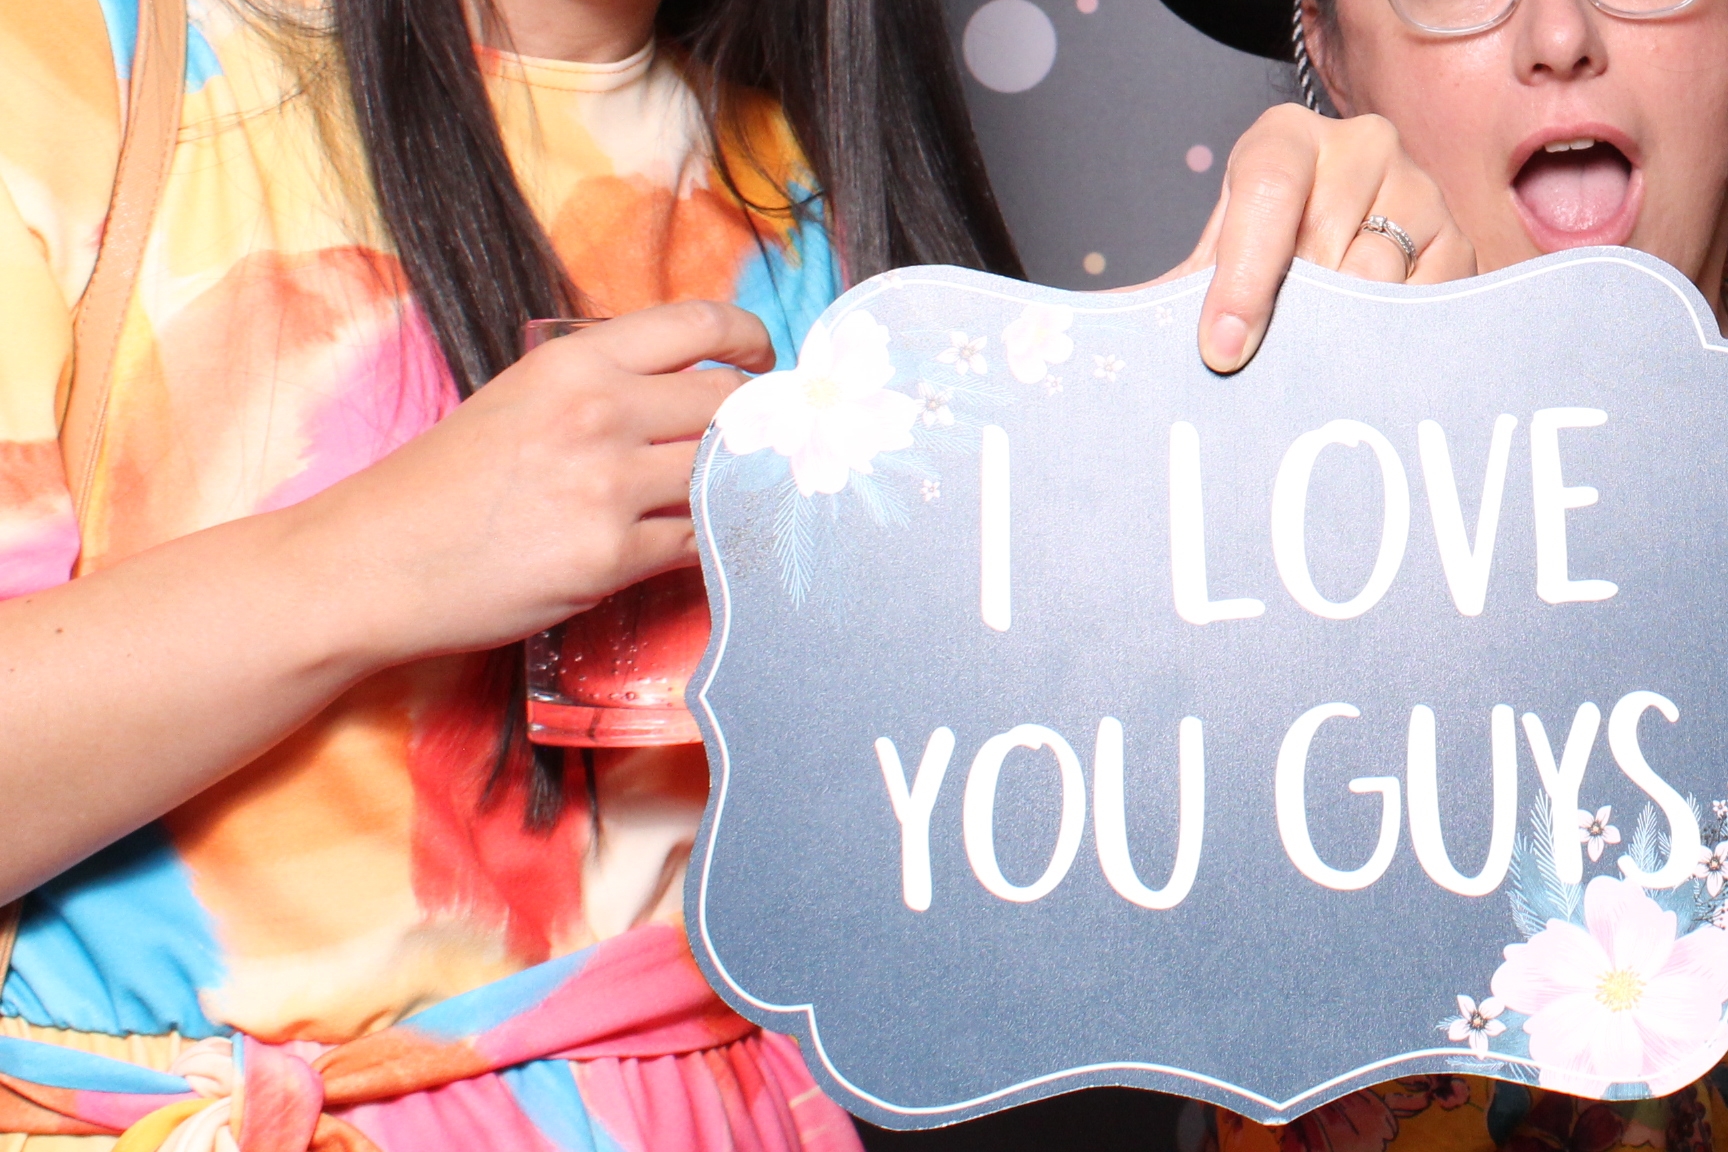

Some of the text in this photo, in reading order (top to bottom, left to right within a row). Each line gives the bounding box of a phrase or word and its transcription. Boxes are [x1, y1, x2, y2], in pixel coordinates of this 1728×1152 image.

[981, 407, 1619, 631] I LOVE
[875, 690, 1702, 911] YOU GUYS
